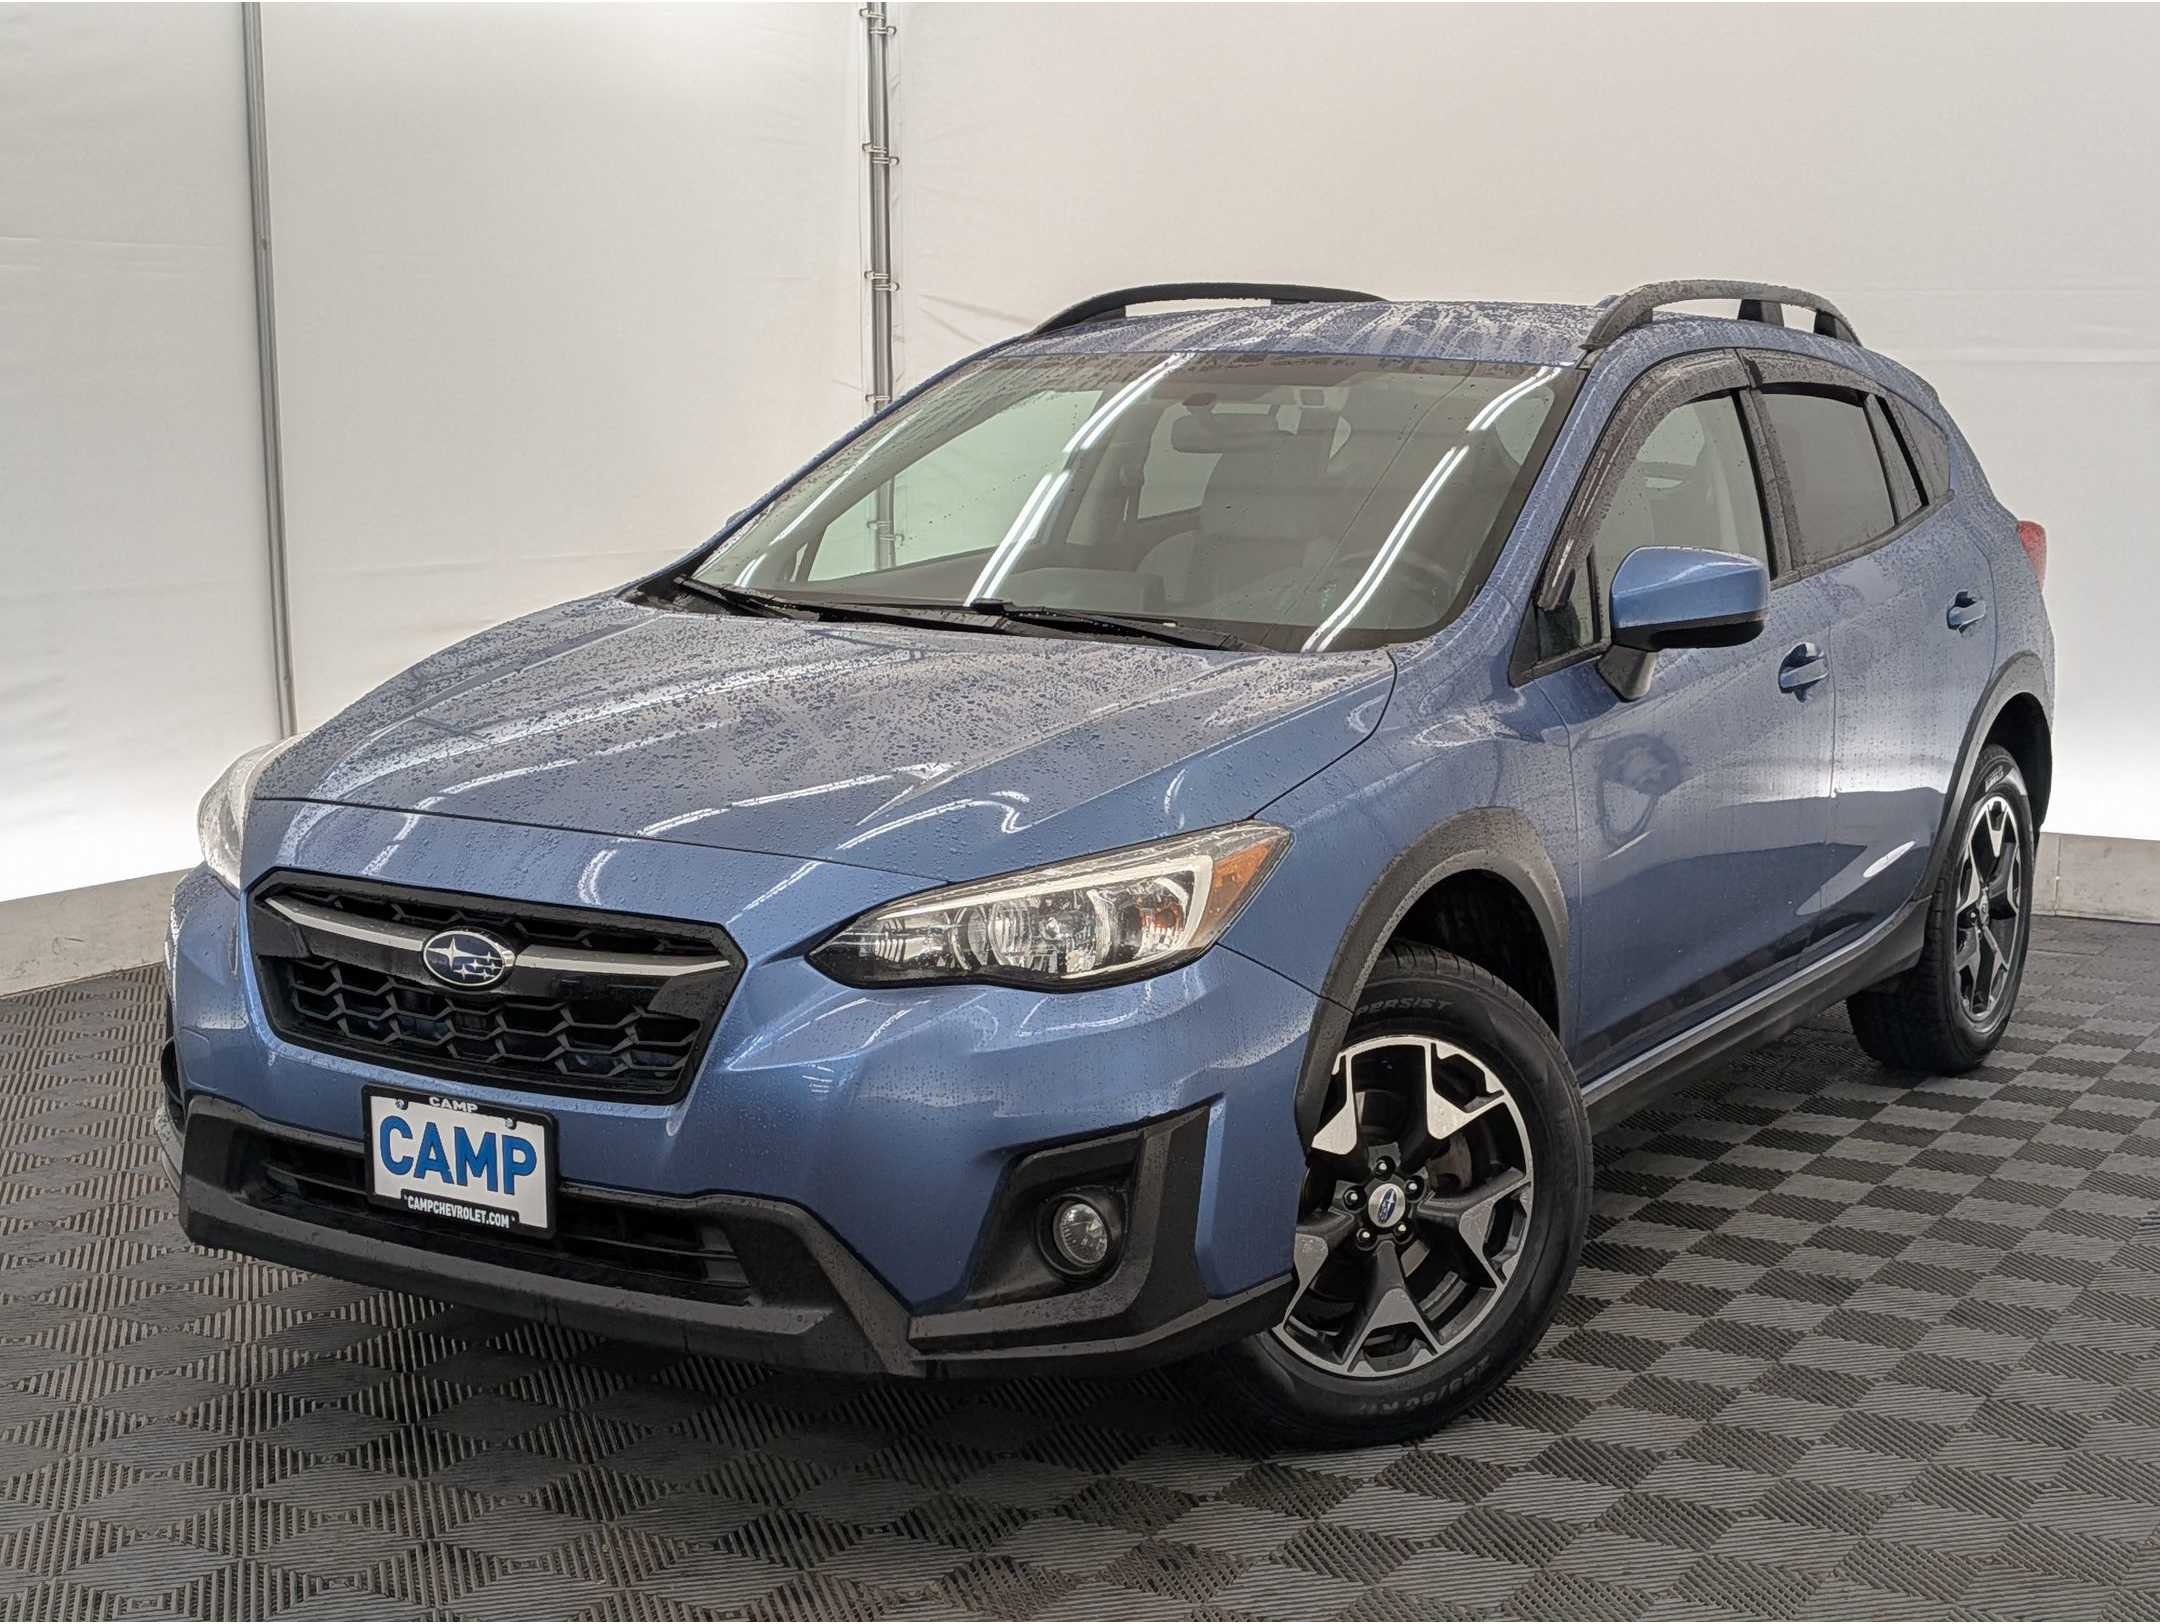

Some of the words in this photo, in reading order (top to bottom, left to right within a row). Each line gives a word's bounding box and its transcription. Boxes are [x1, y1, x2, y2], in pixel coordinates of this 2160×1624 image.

[429, 1096, 478, 1113] CAMP
[380, 1115, 537, 1195] CAMP
[407, 1195, 510, 1228] CAMPCHEVROLET.COM
